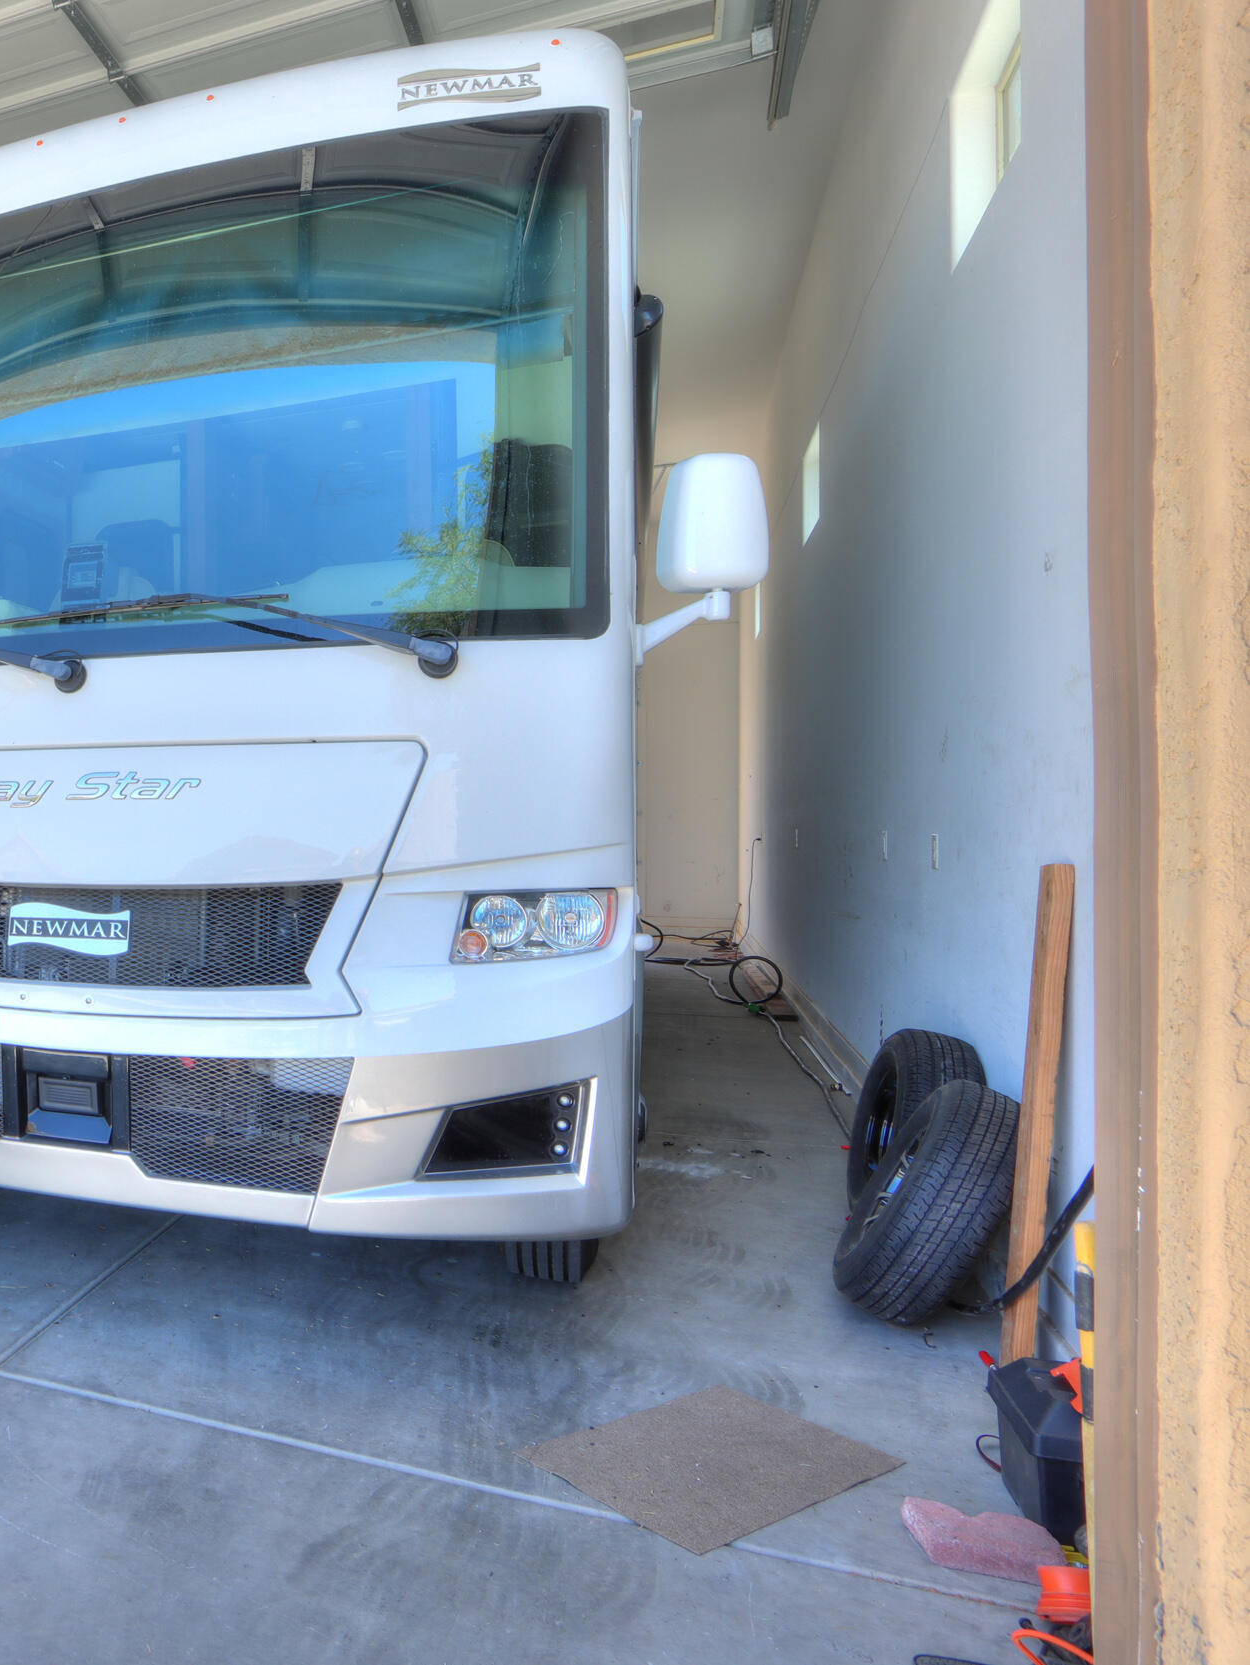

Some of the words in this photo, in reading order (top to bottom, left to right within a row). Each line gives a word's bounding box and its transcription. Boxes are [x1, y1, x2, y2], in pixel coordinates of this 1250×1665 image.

[401, 73, 539, 100] NEWMAR
[66, 771, 201, 800] Star
[12, 919, 127, 939] NEWMAR
